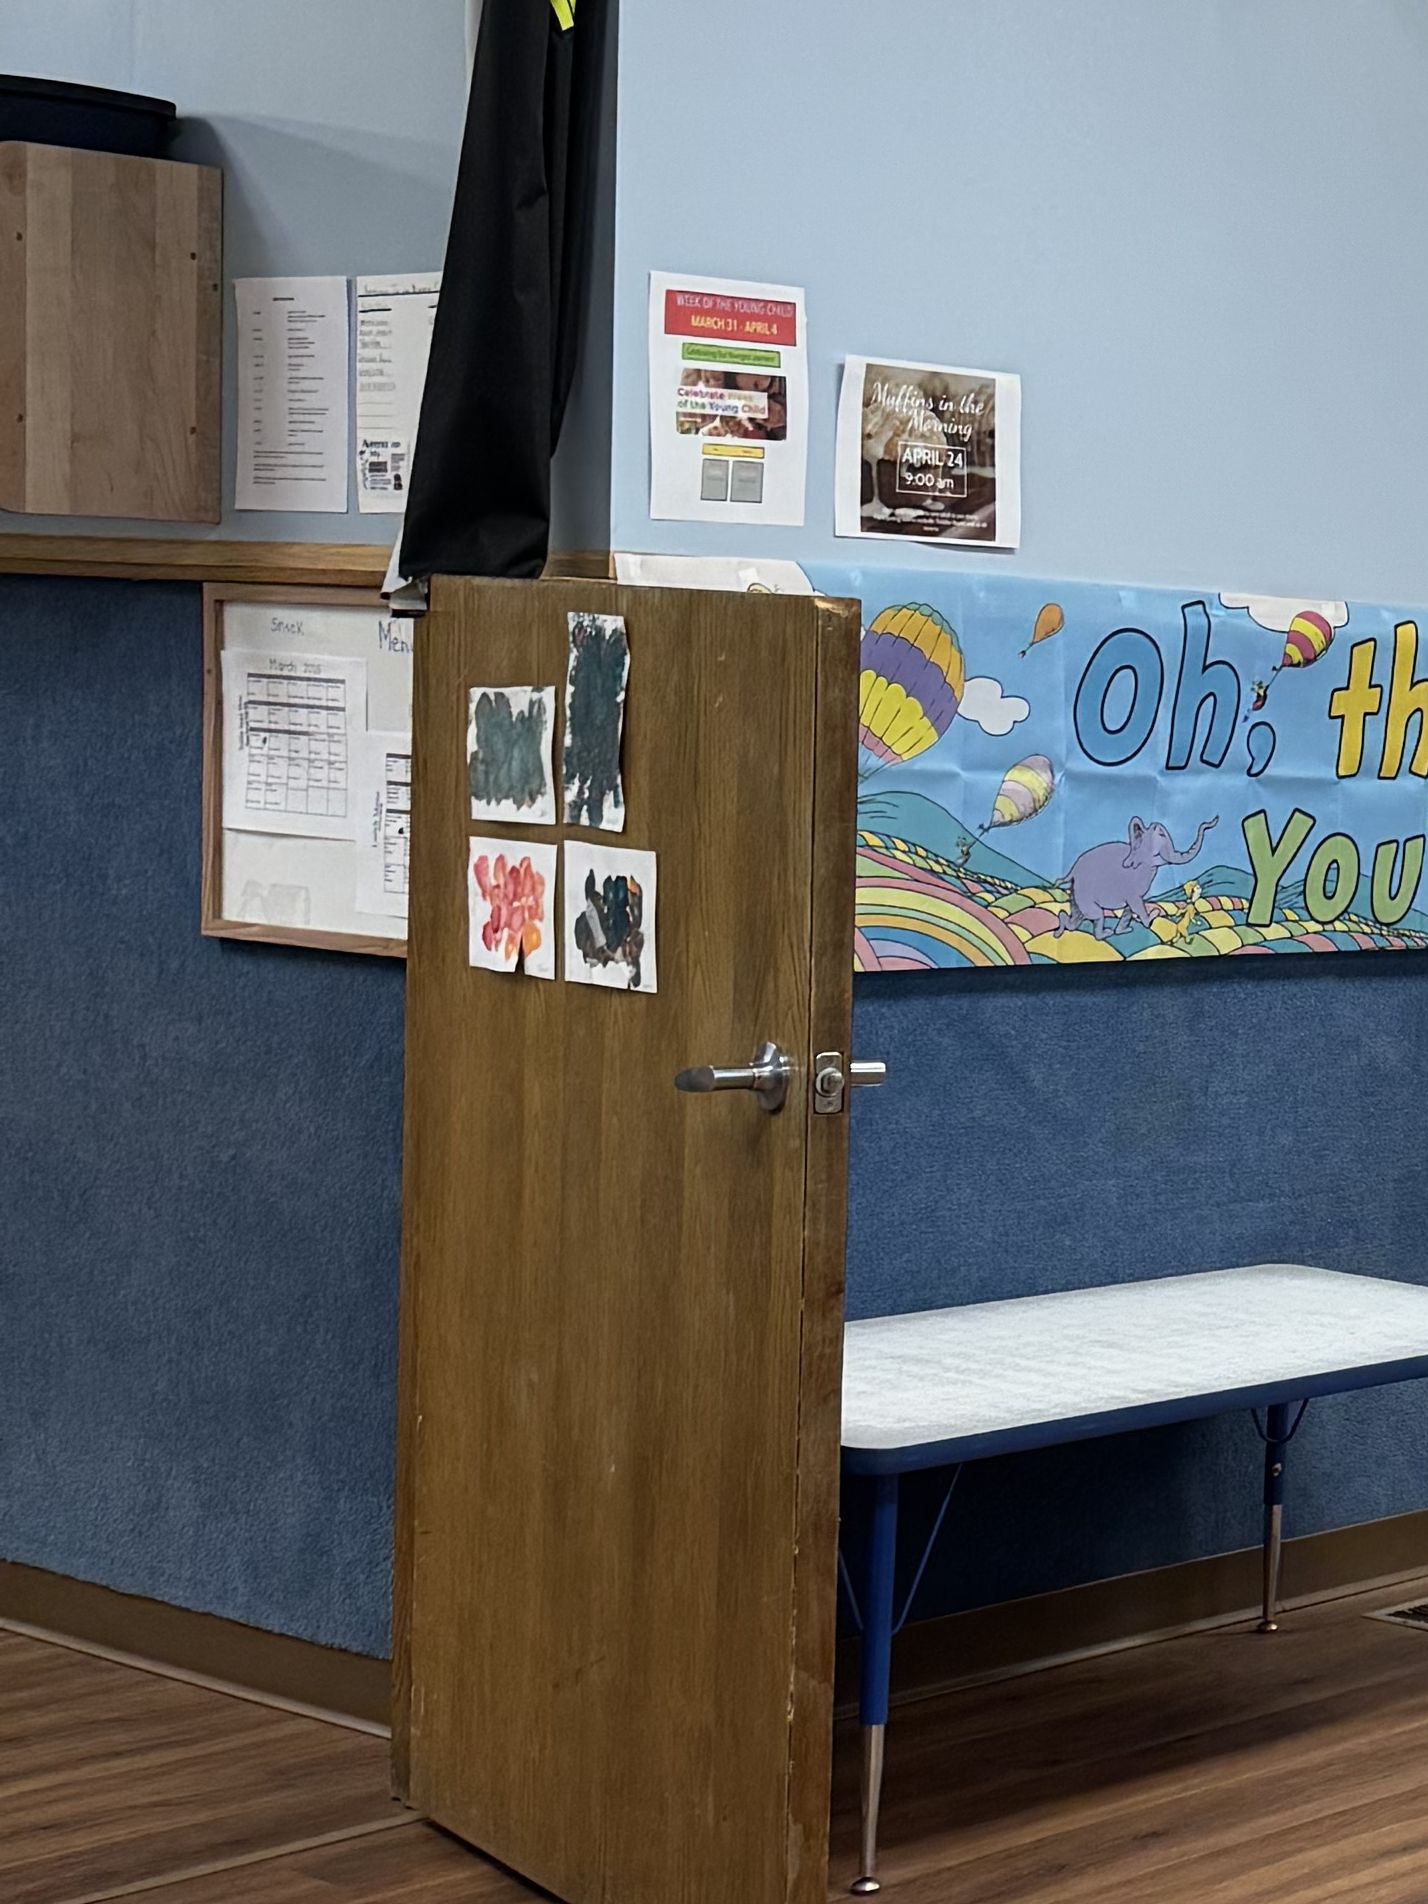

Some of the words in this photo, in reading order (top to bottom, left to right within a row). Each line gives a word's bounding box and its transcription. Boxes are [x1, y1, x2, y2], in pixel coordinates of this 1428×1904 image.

[676, 293, 700, 307] WEEK
[702, 297, 714, 308] OF
[716, 299, 731, 312] THE
[733, 301, 765, 315] YOUNG
[691, 315, 724, 330] MARCH
[727, 318, 737, 331] 31
[744, 321, 770, 335] APRIL
[677, 388, 725, 400] Celebrate
[870, 381, 934, 417] Muffins
[938, 395, 954, 412] in
[959, 392, 985, 416] the
[708, 402, 738, 414] Young
[906, 410, 973, 443] Morning
[902, 448, 944, 467] APRIL
[947, 451, 963, 469] 24
[905, 472, 935, 486] 9:00
[378, 620, 414, 654] Men
